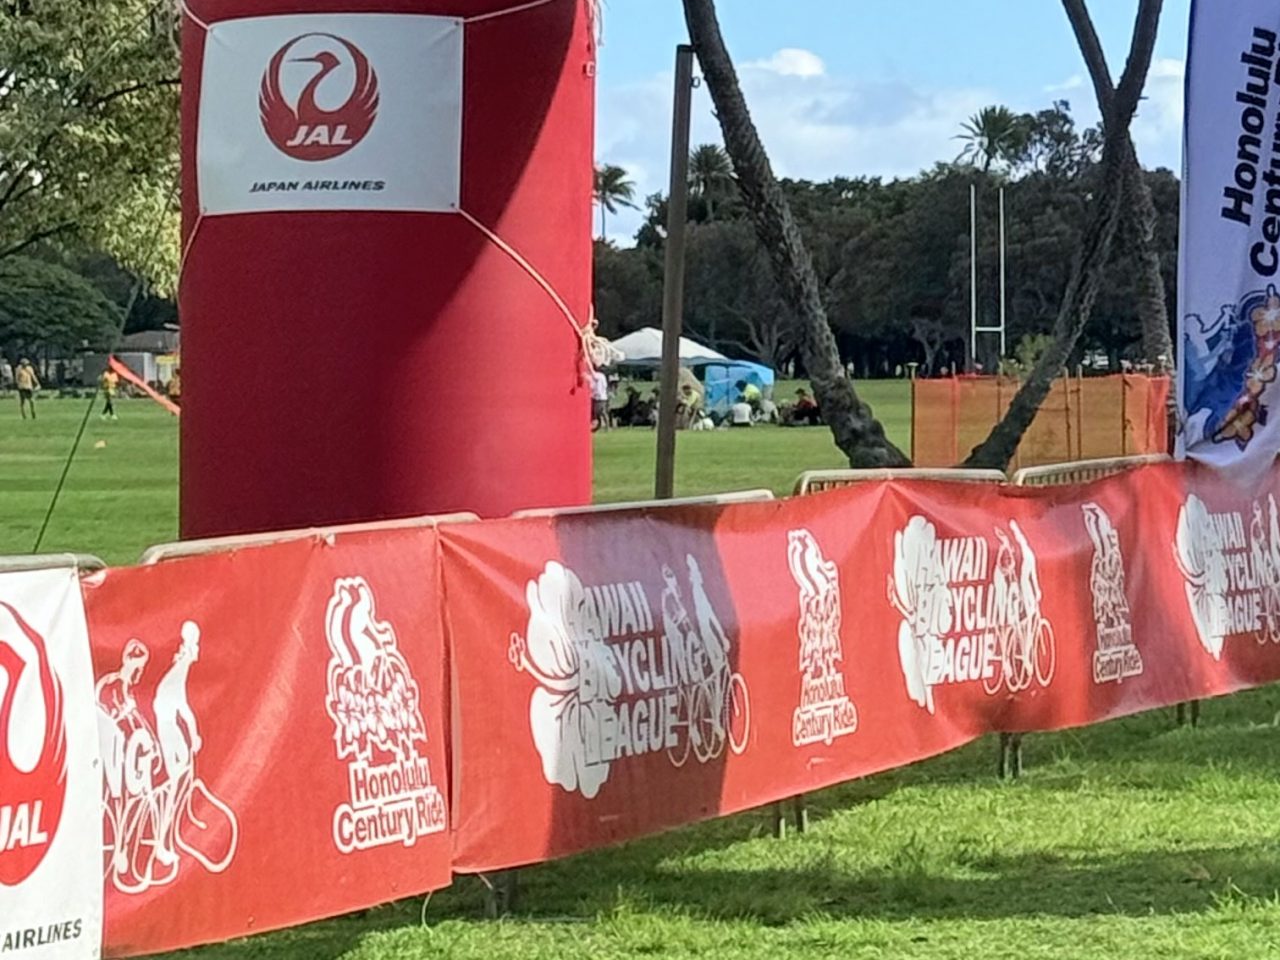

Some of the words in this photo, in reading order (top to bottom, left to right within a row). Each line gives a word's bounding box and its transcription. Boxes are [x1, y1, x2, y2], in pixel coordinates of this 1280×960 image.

[286, 125, 352, 146] JAL
[1221, 27, 1277, 226] Honolulu
[249, 181, 299, 193] JAPAN
[301, 180, 386, 191] AIRLINES
[353, 758, 428, 802] Honolulu
[338, 806, 413, 846] Century
[2, 918, 82, 953] AIRLINES
